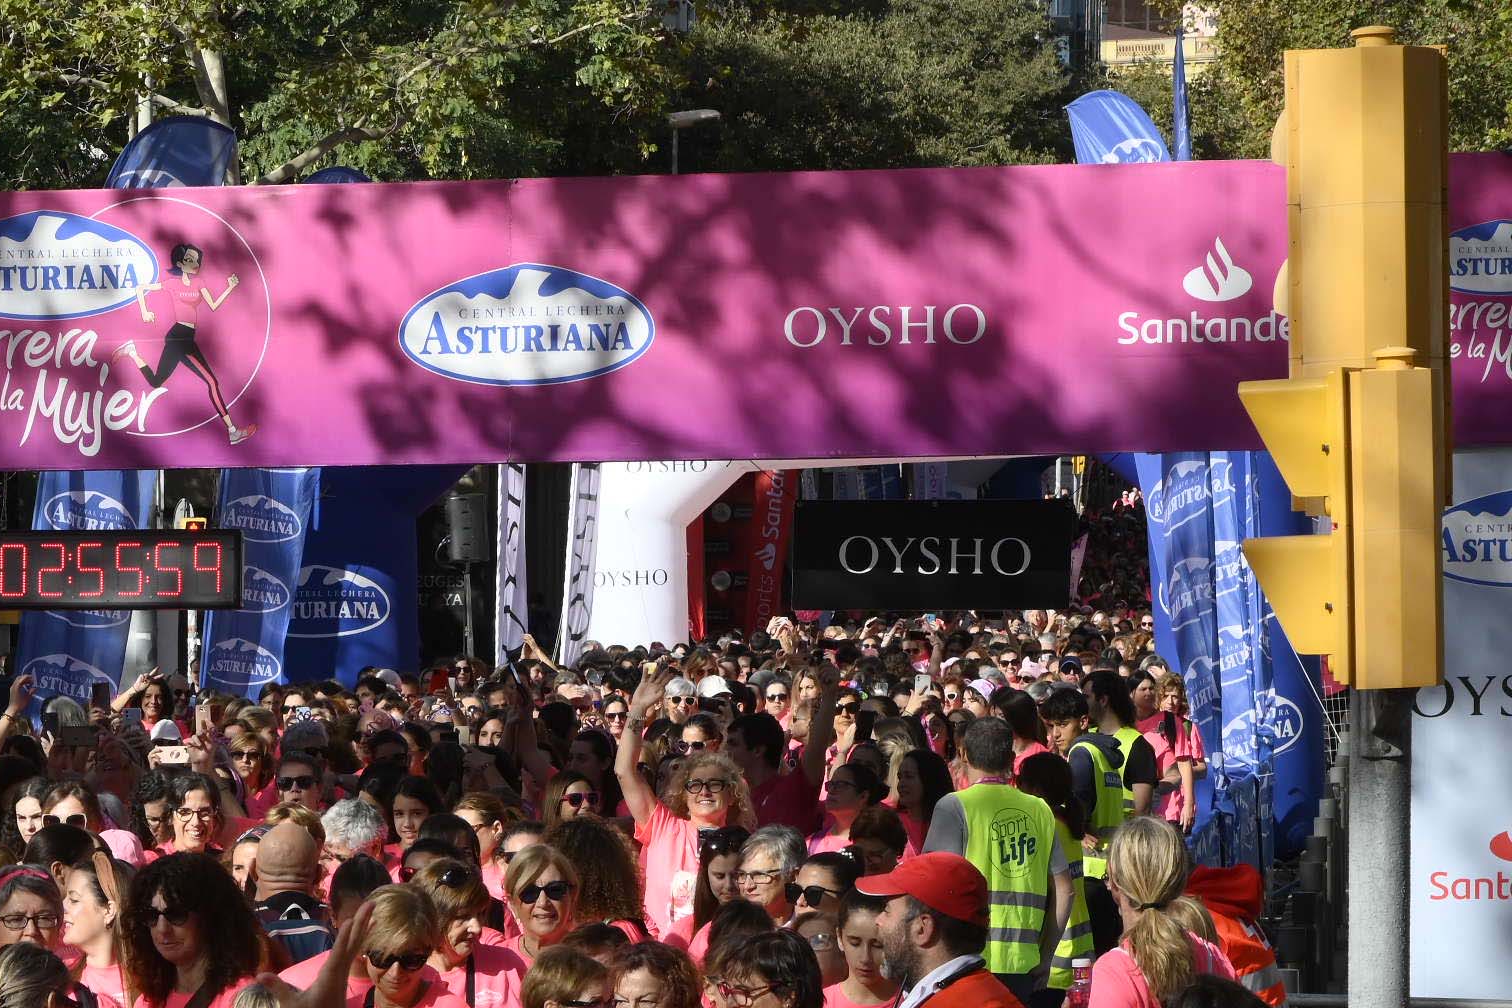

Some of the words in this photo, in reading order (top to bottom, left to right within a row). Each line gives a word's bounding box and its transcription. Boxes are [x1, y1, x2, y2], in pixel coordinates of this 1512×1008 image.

[61, 247, 134, 259] LECHERA
[458, 305, 536, 319] CENTRAL
[545, 304, 626, 317] LECHERA
[783, 303, 987, 348] OYSHO
[419, 311, 635, 355] ASTURIANA
[1117, 310, 1290, 346] Santande
[1467, 330, 1486, 359] la
[0, 370, 25, 412] la
[19, 361, 168, 457] Mujer
[224, 510, 294, 536] ASTURIANA
[0, 542, 221, 597] 02:55:59
[838, 535, 1032, 577] OYSHO
[593, 567, 669, 588] OYSHO
[244, 587, 282, 604] RIANA
[991, 814, 1029, 842] Sport
[999, 832, 1036, 866] Life
